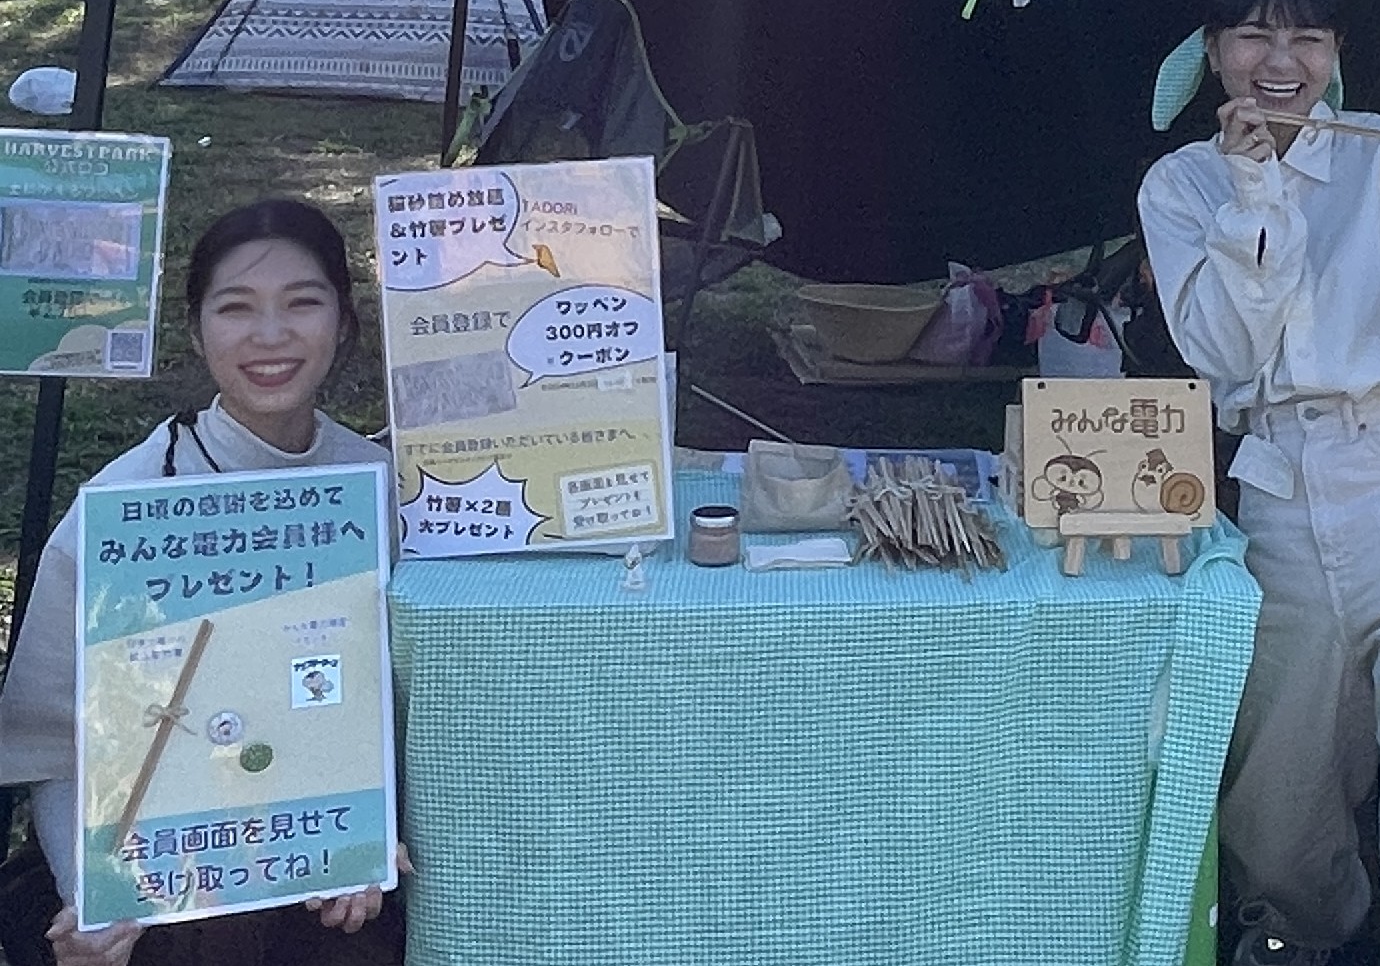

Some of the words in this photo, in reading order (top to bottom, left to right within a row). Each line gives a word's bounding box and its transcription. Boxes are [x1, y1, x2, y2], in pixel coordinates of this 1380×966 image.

[391, 247, 428, 266] ント
[556, 295, 627, 315] ワッペン
[410, 310, 511, 335] 会員登録で
[546, 321, 639, 340] 300円オフ
[560, 347, 630, 366] クーポン
[1051, 398, 1186, 438] みんな電力
[122, 486, 344, 522] 日頃の感謝を込めて
[419, 519, 514, 540] 大プレゼント
[100, 520, 365, 565] みんな電力会員様へ
[122, 806, 351, 863] 会員画面を見せて
